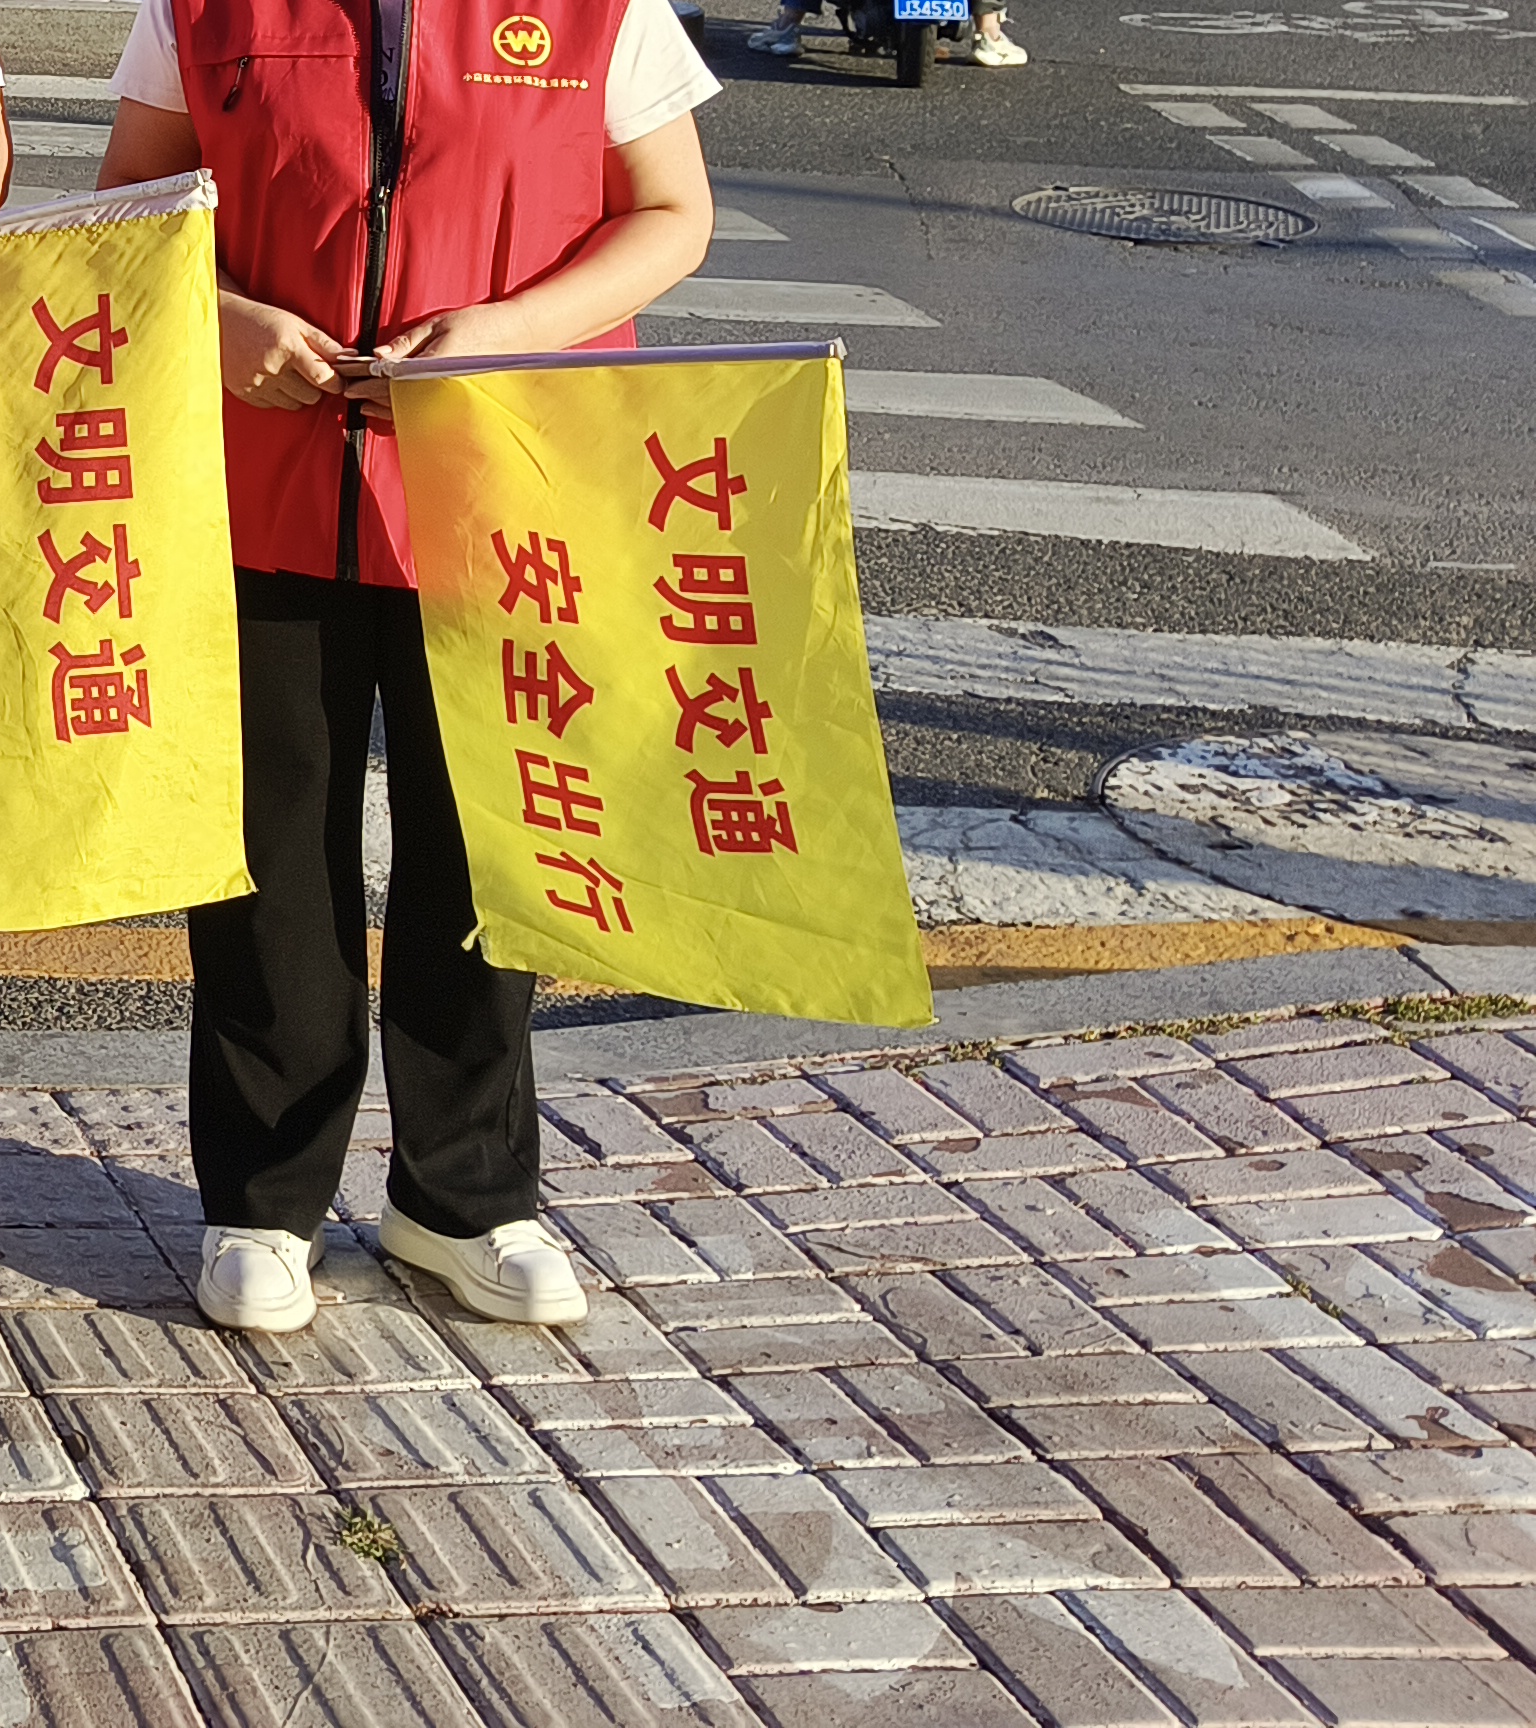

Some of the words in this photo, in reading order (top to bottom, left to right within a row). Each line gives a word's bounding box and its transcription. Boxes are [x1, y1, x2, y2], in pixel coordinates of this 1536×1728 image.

[900, 0, 964, 18] J34530
[31, 292, 152, 744] 文明交通
[643, 431, 800, 857] 文明交通
[489, 528, 635, 934] 安全出行
